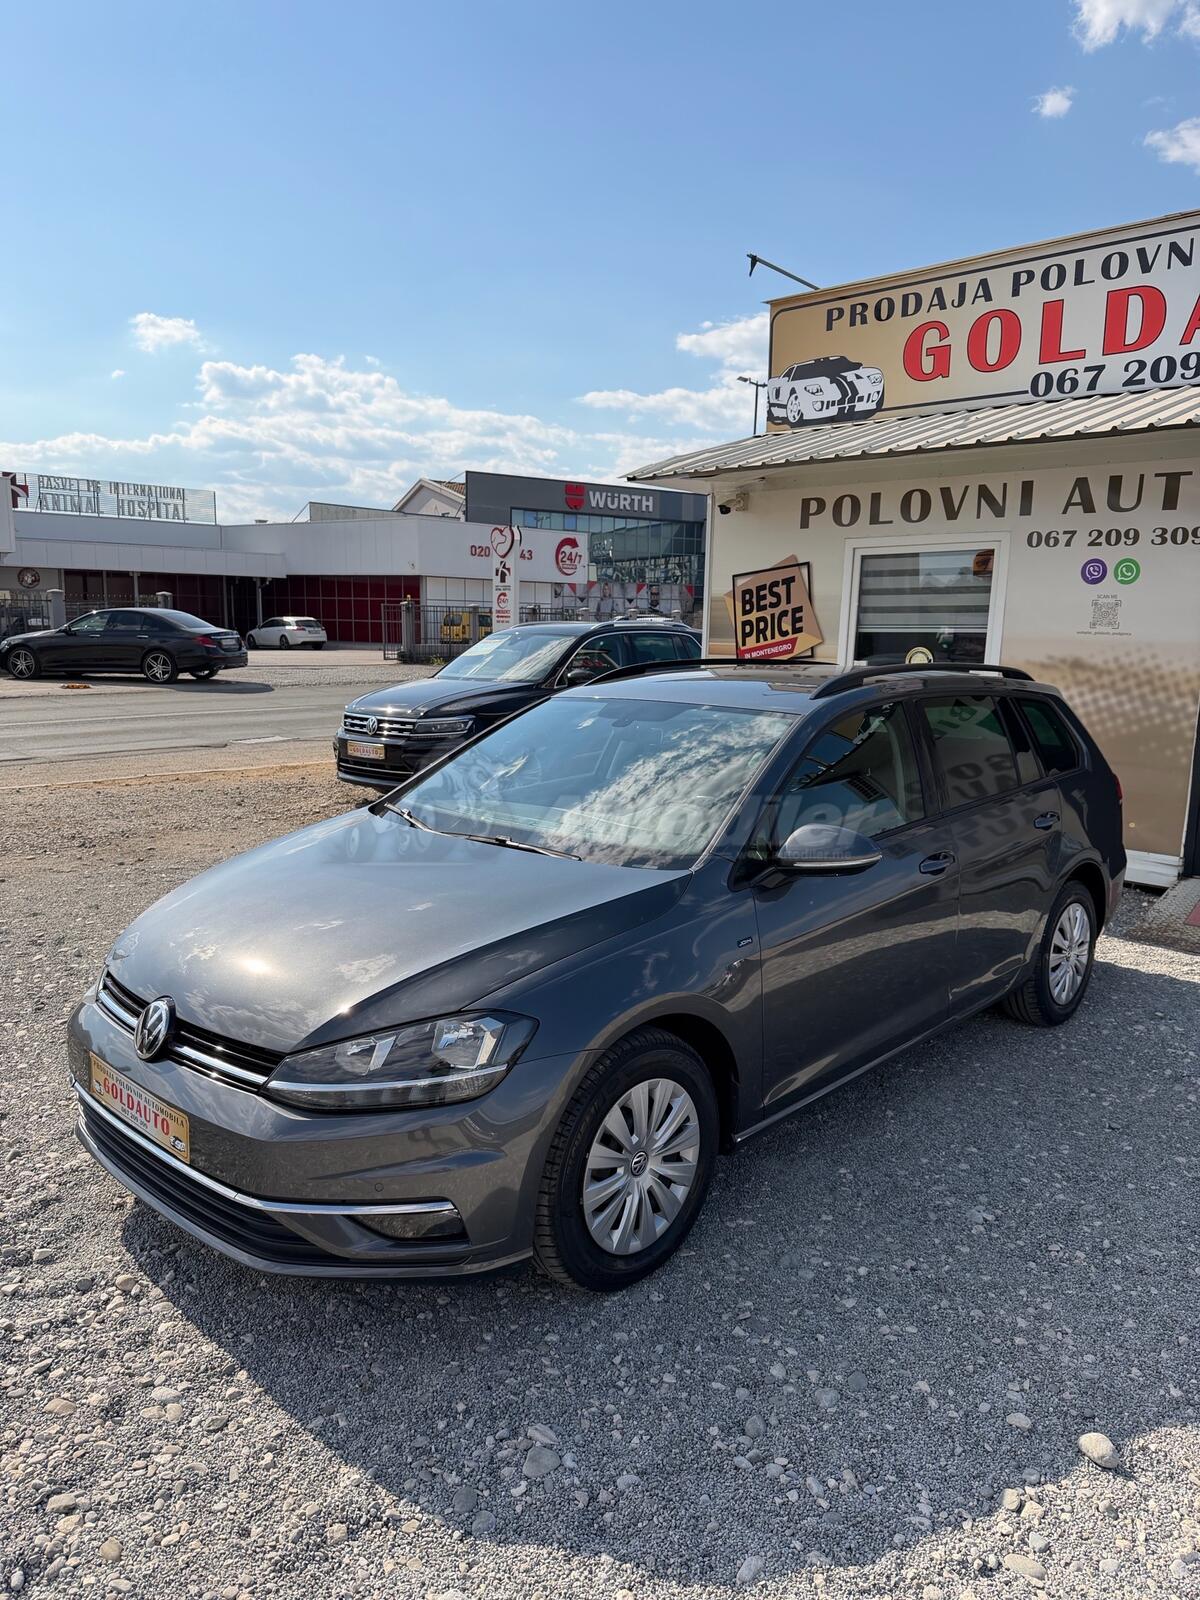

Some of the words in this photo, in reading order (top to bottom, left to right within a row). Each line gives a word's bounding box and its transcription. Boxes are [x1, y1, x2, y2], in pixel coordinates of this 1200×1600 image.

[825, 277, 993, 332] PRODAJA
[1011, 237, 1195, 298] POLOVN
[1030, 364, 1106, 398] 067
[1122, 351, 1200, 388] 209
[41, 492, 104, 515] ANIMAL
[117, 498, 189, 521] HOSPITAL
[589, 491, 653, 512] WÜRTH
[799, 480, 1034, 529] POLOVNI
[1061, 471, 1193, 514] AUT
[470, 545, 490, 557] 020
[1026, 530, 1077, 548] 067
[1087, 528, 1140, 547] 209
[741, 575, 796, 616] BEST
[741, 606, 804, 647] PRICE
[751, 643, 792, 657] MONTENEGRO
[103, 1077, 170, 1136] GOLDAUTO
[144, 1095, 184, 1128] AUTOMOBILA
